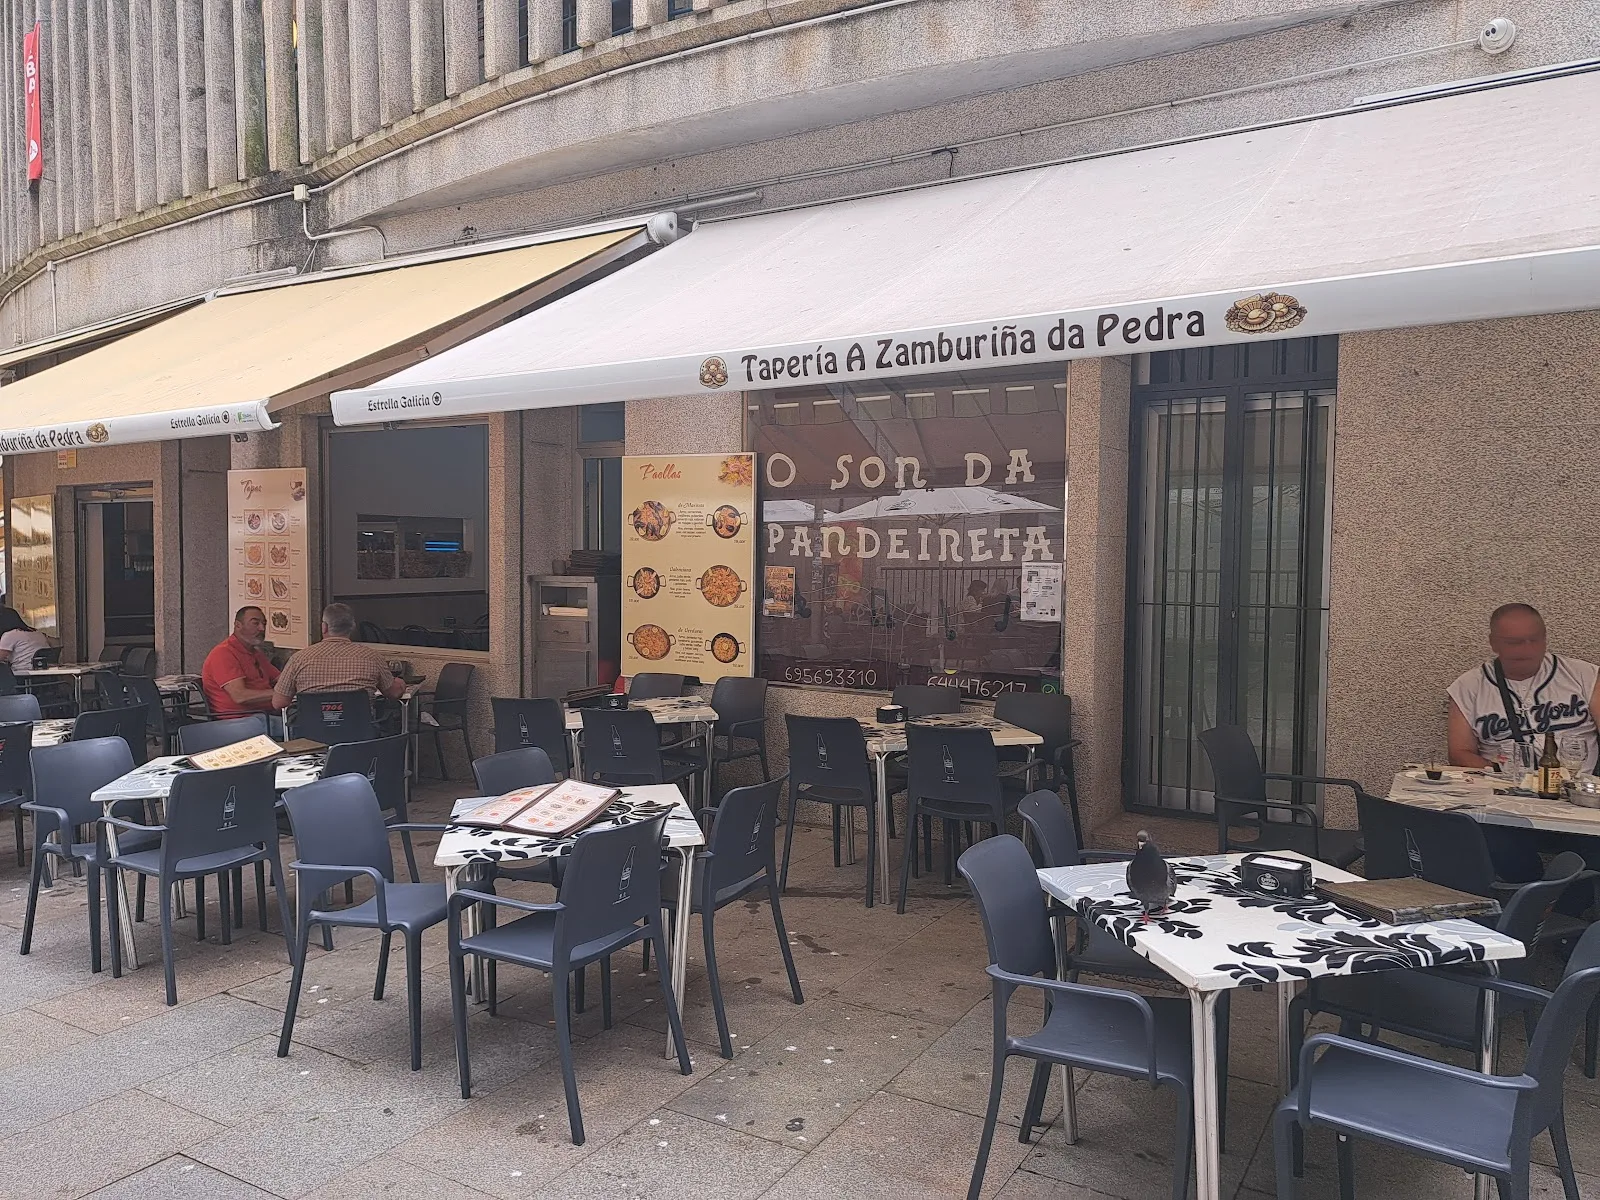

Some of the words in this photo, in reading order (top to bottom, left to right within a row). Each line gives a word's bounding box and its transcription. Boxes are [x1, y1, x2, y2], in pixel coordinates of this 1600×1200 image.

[741, 345, 838, 382] Tapería
[846, 342, 866, 372] A
[876, 324, 1036, 369] Zamburiña
[1047, 318, 1085, 351] da
[1097, 306, 1205, 347] Pedra
[368, 398, 399, 411] Estrella
[400, 393, 430, 408] Galicia
[170, 416, 196, 429] Estrella
[196, 413, 221, 426] Galicia
[35, 430, 50, 448] da
[49, 427, 84, 447] Pedra
[639, 463, 682, 480] Paellas
[766, 452, 796, 488] O
[964, 449, 1035, 486] DA
[785, 666, 877, 686] 695693310
[1530, 694, 1588, 733] York
